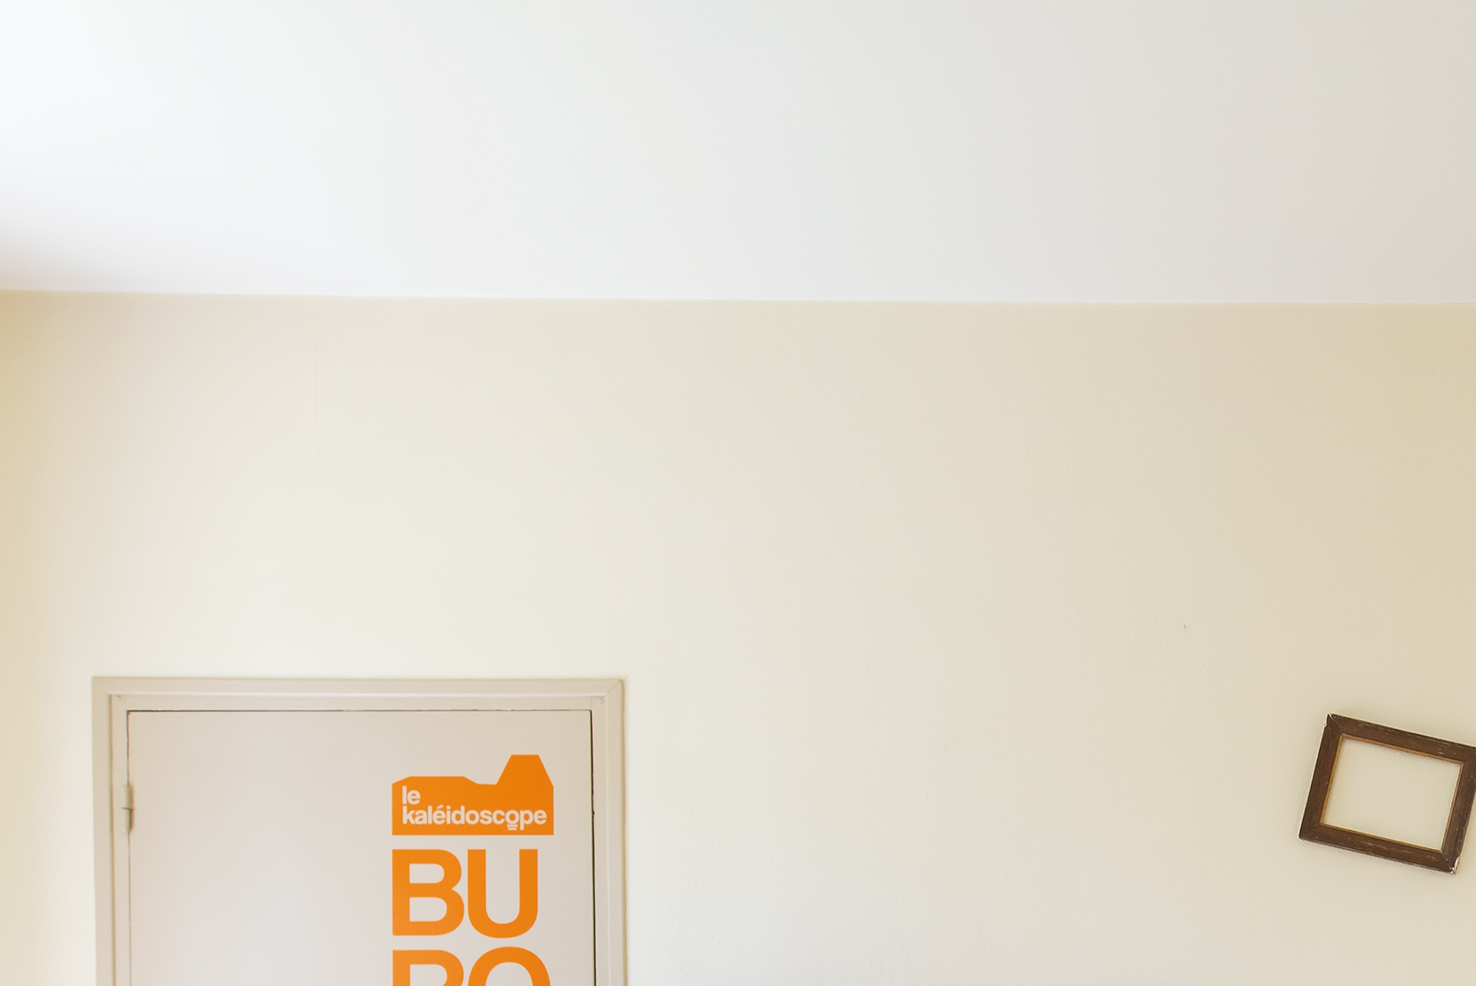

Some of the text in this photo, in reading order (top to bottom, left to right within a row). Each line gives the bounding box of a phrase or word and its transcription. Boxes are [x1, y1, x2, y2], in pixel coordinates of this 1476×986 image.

[402, 785, 421, 805] le
[402, 804, 547, 831] kaléidoscope
[391, 848, 539, 939] BU
